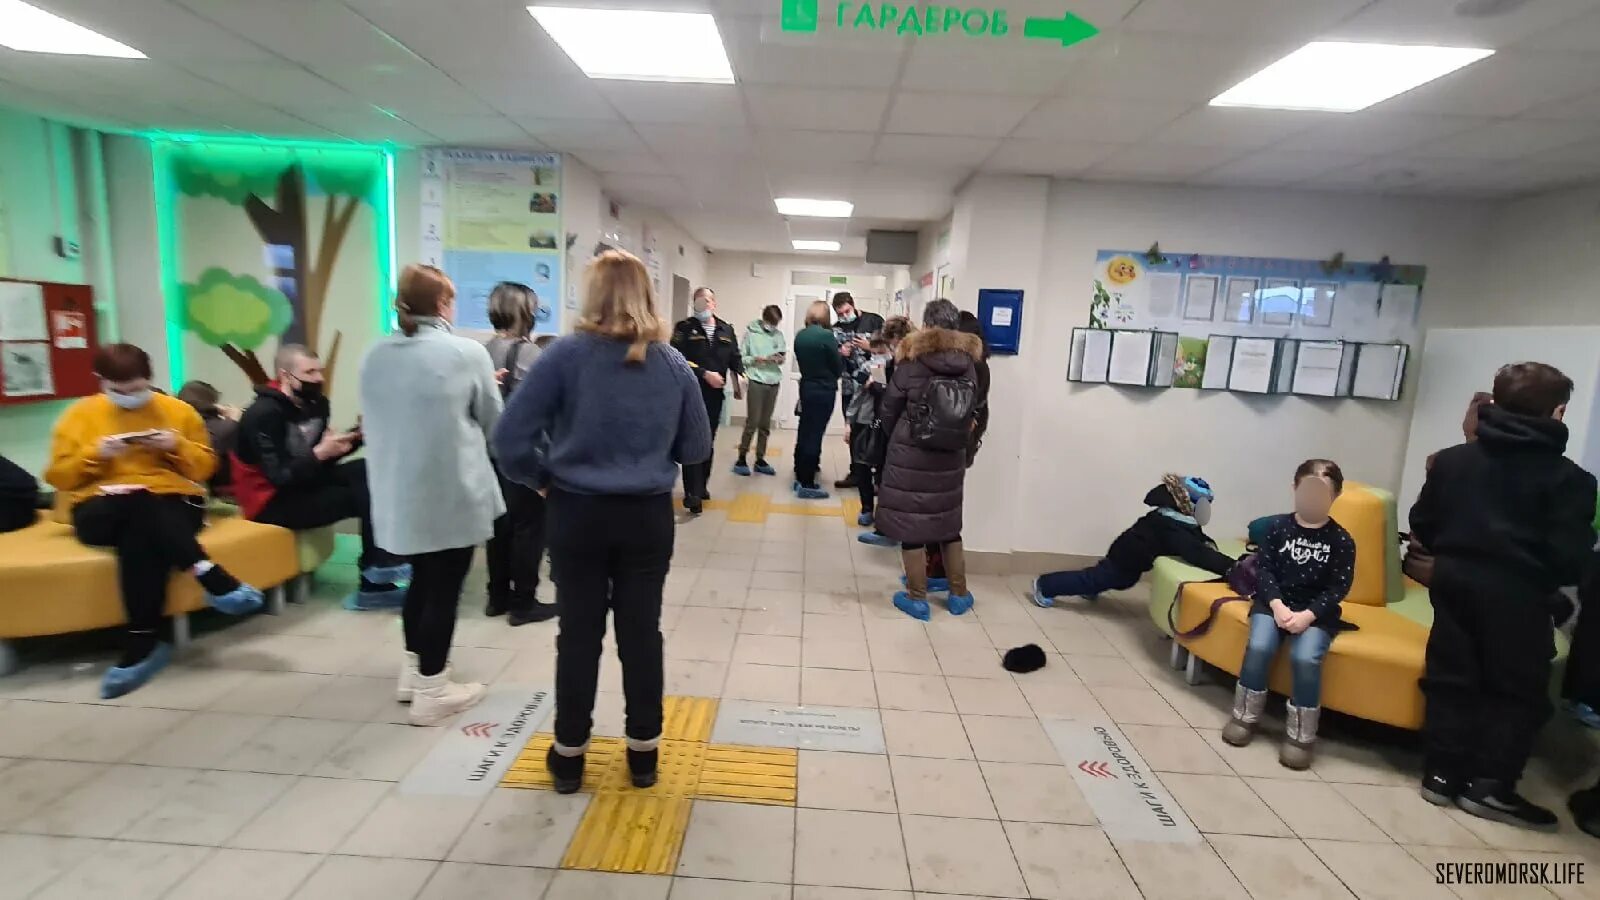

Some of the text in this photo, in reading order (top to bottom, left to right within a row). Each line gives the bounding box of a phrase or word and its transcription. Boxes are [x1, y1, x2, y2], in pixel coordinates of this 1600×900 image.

[837, 2, 1008, 36] ГАРДЕРОБ
[467, 749, 505, 781] ШАГИ
[1093, 726, 1177, 827] ШАГИ К ЗДОРОВЬЮ
